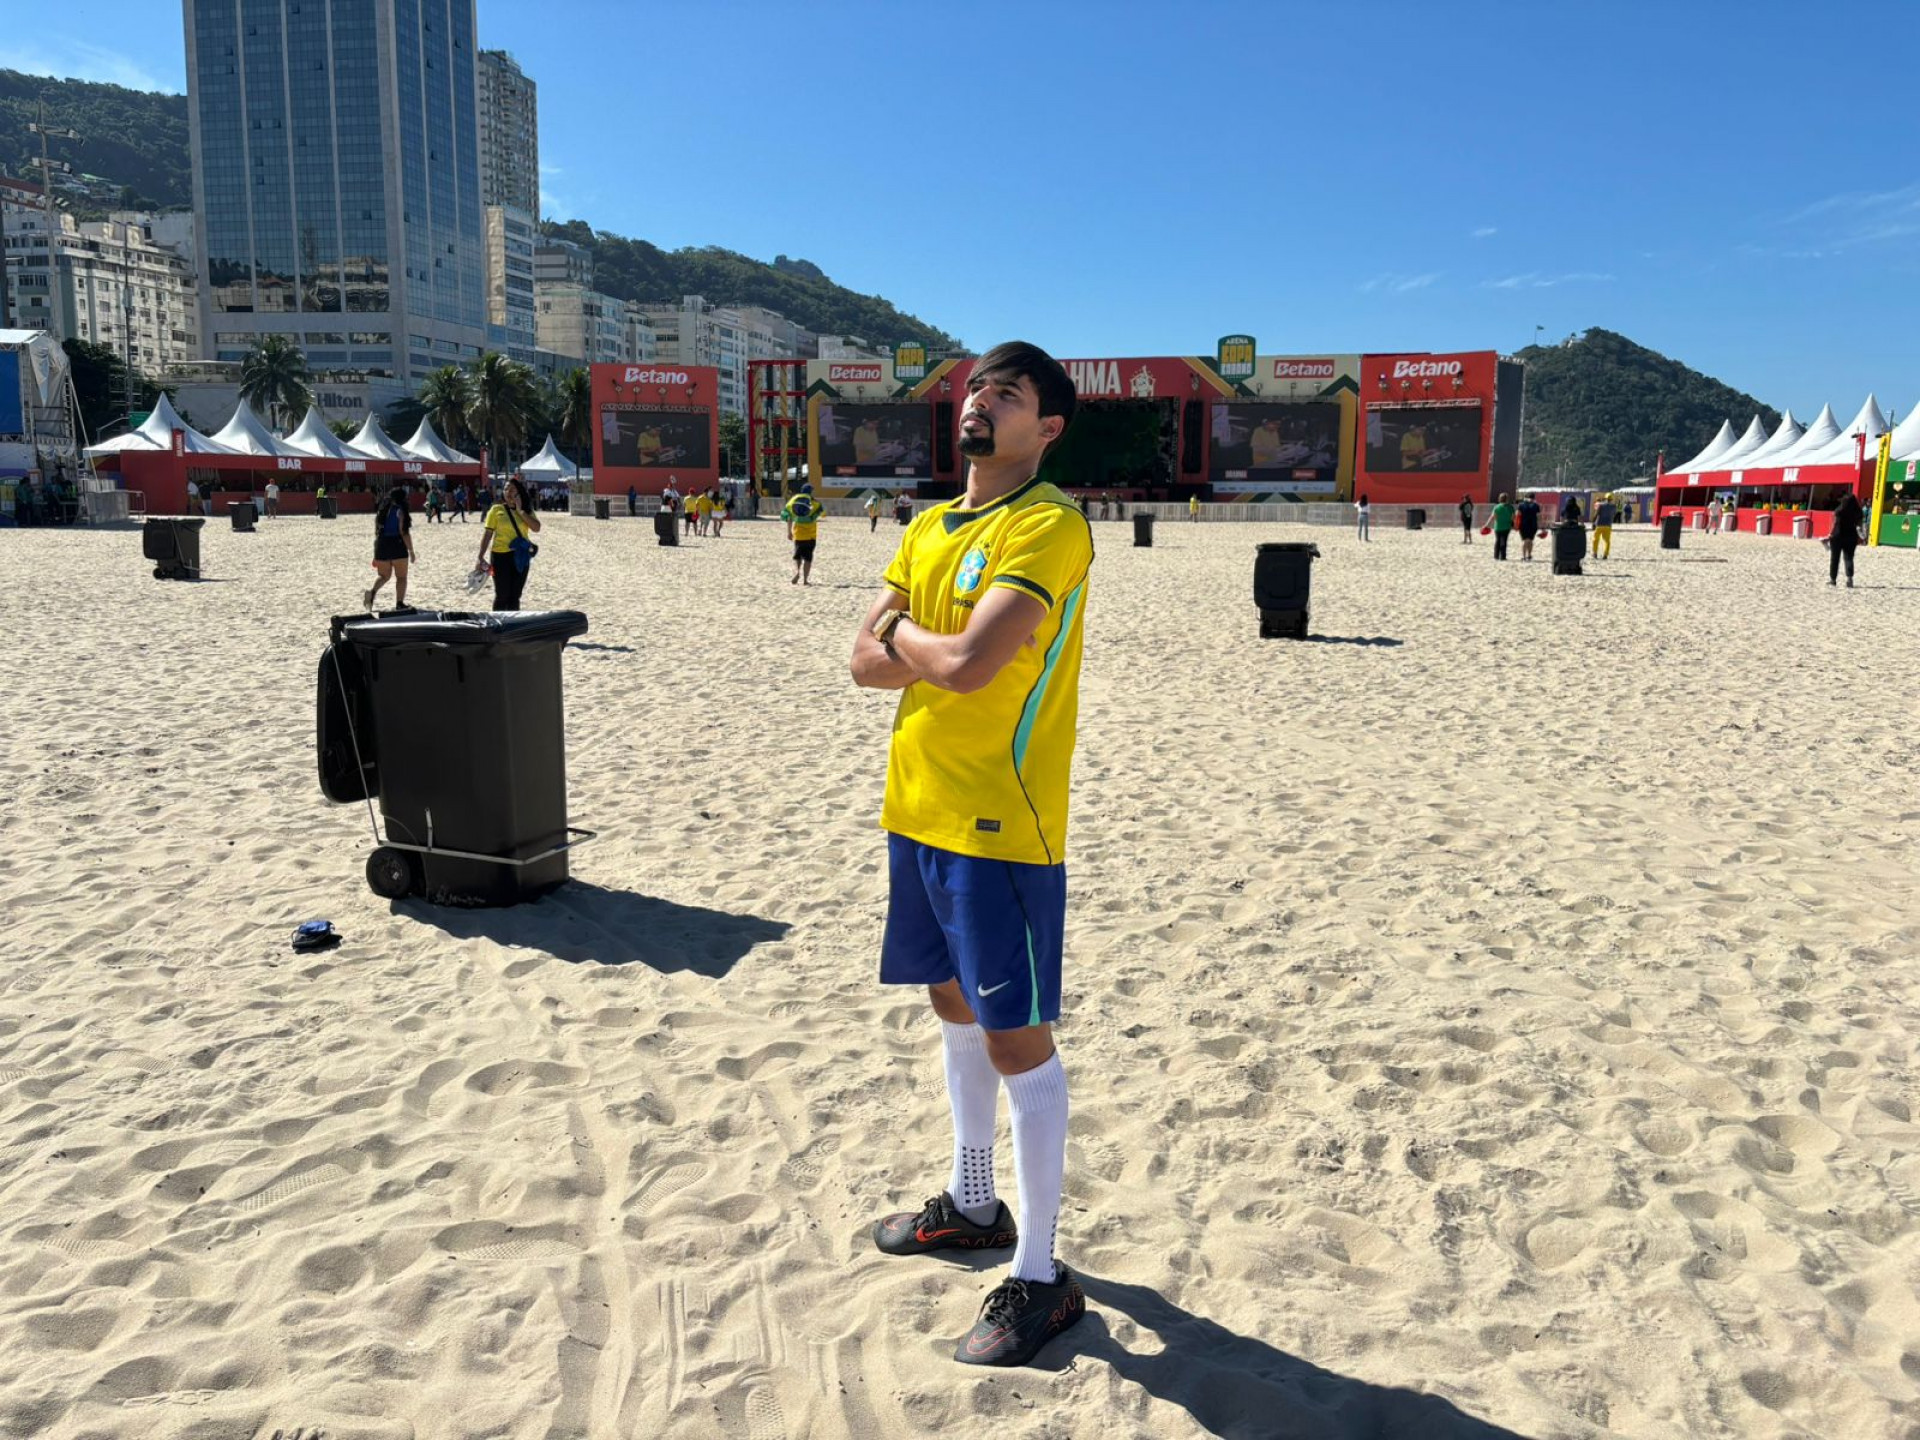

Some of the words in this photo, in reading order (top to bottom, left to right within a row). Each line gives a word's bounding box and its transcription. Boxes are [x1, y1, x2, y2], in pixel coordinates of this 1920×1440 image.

[624, 367, 688, 384] Betano
[831, 366, 880, 379] Betano
[1275, 361, 1333, 376] Betano
[1393, 360, 1462, 378] Betano
[1060, 361, 1122, 395] HMA
[317, 392, 363, 408] Hilton
[277, 458, 302, 470] BAR
[403, 463, 423, 473] BAR
